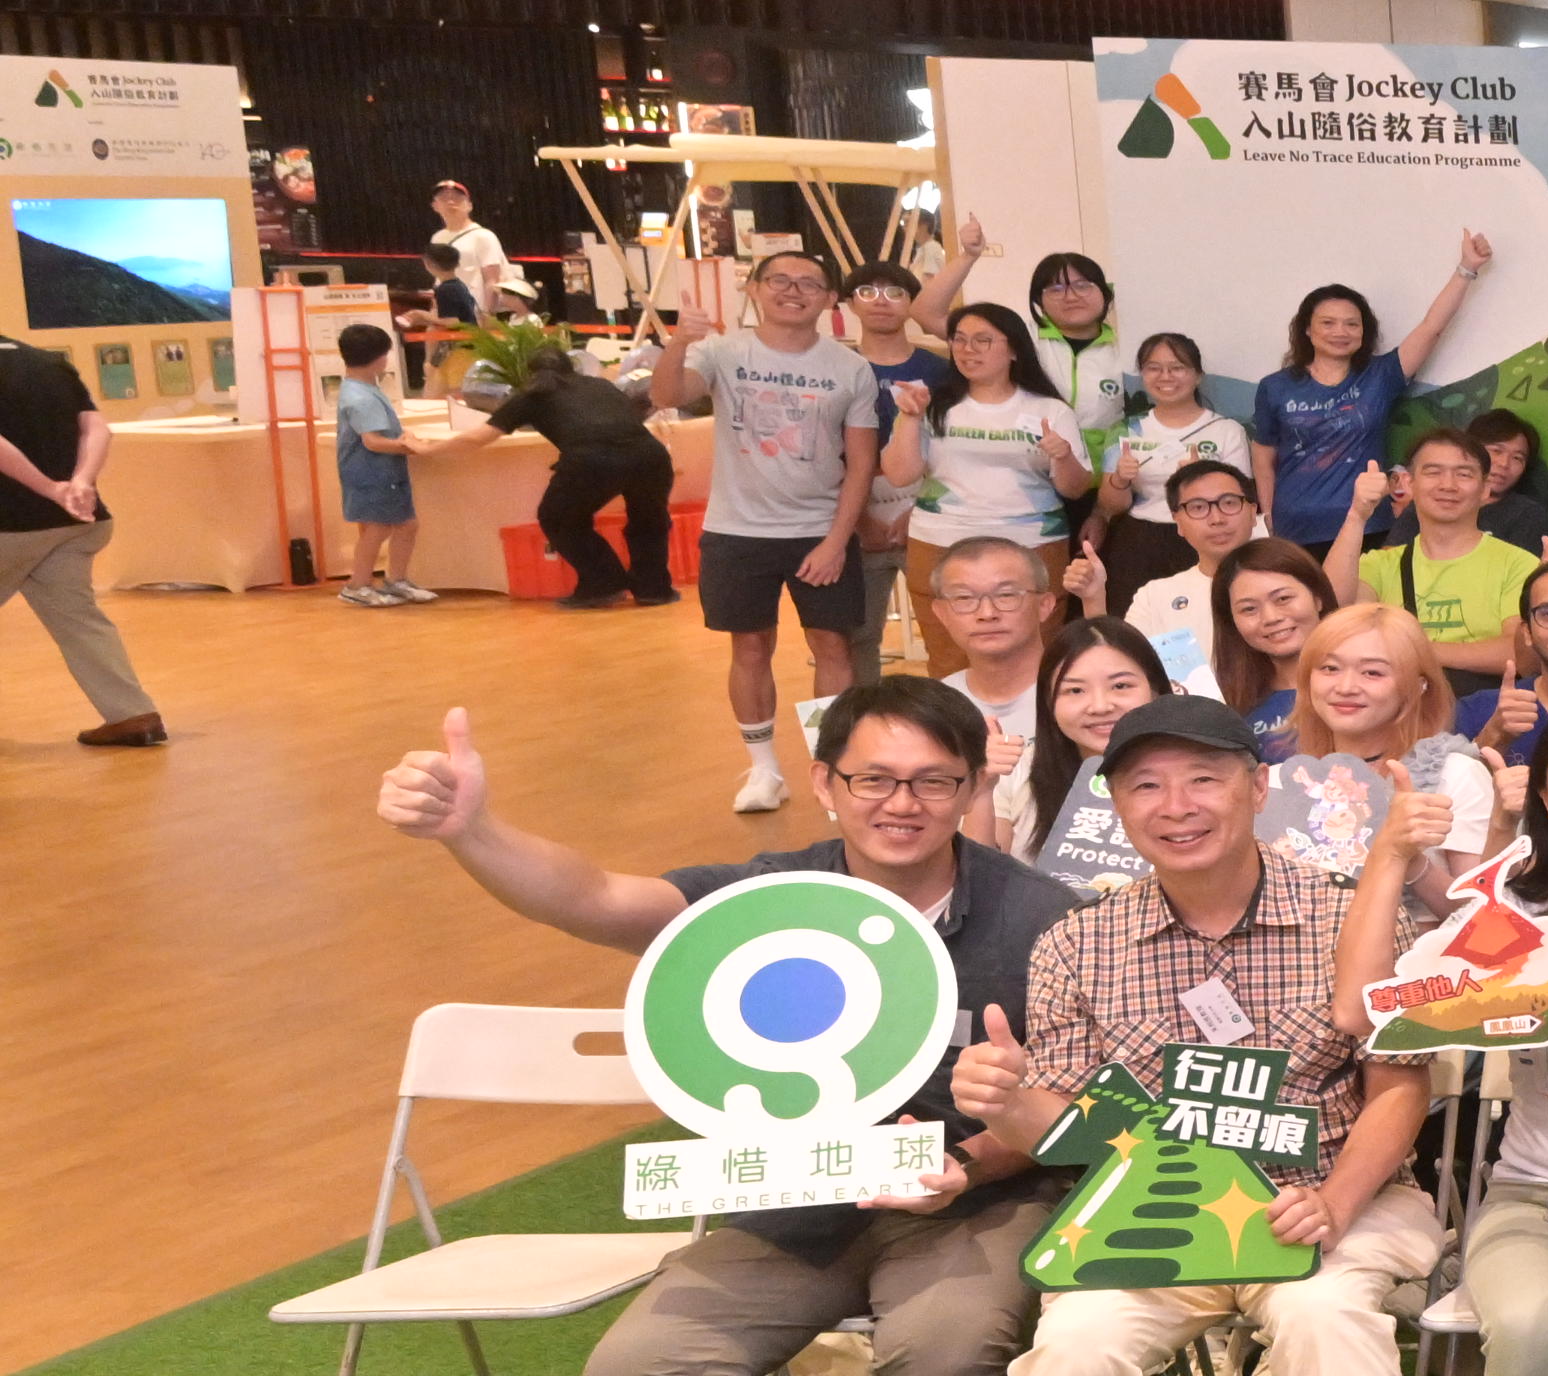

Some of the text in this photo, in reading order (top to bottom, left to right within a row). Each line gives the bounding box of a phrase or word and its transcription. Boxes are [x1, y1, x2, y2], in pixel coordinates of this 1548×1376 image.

[1238, 71, 1516, 106] 賽馬會 Jockey Club
[1242, 111, 1519, 145] 入山隨俗教育計劃
[1243, 149, 1520, 169] Leave No Trace Education Programme
[1057, 843, 1144, 871] Protect
[1369, 969, 1484, 1012] 尊重他人
[1489, 1019, 1527, 1033] 鳳凰山
[1174, 1047, 1272, 1102] 行山
[1161, 1099, 1310, 1157] 不留痕
[636, 1134, 935, 1192] 綠惜地球
[636, 1201, 693, 1217] THE
[712, 1190, 816, 1211] GREEN
